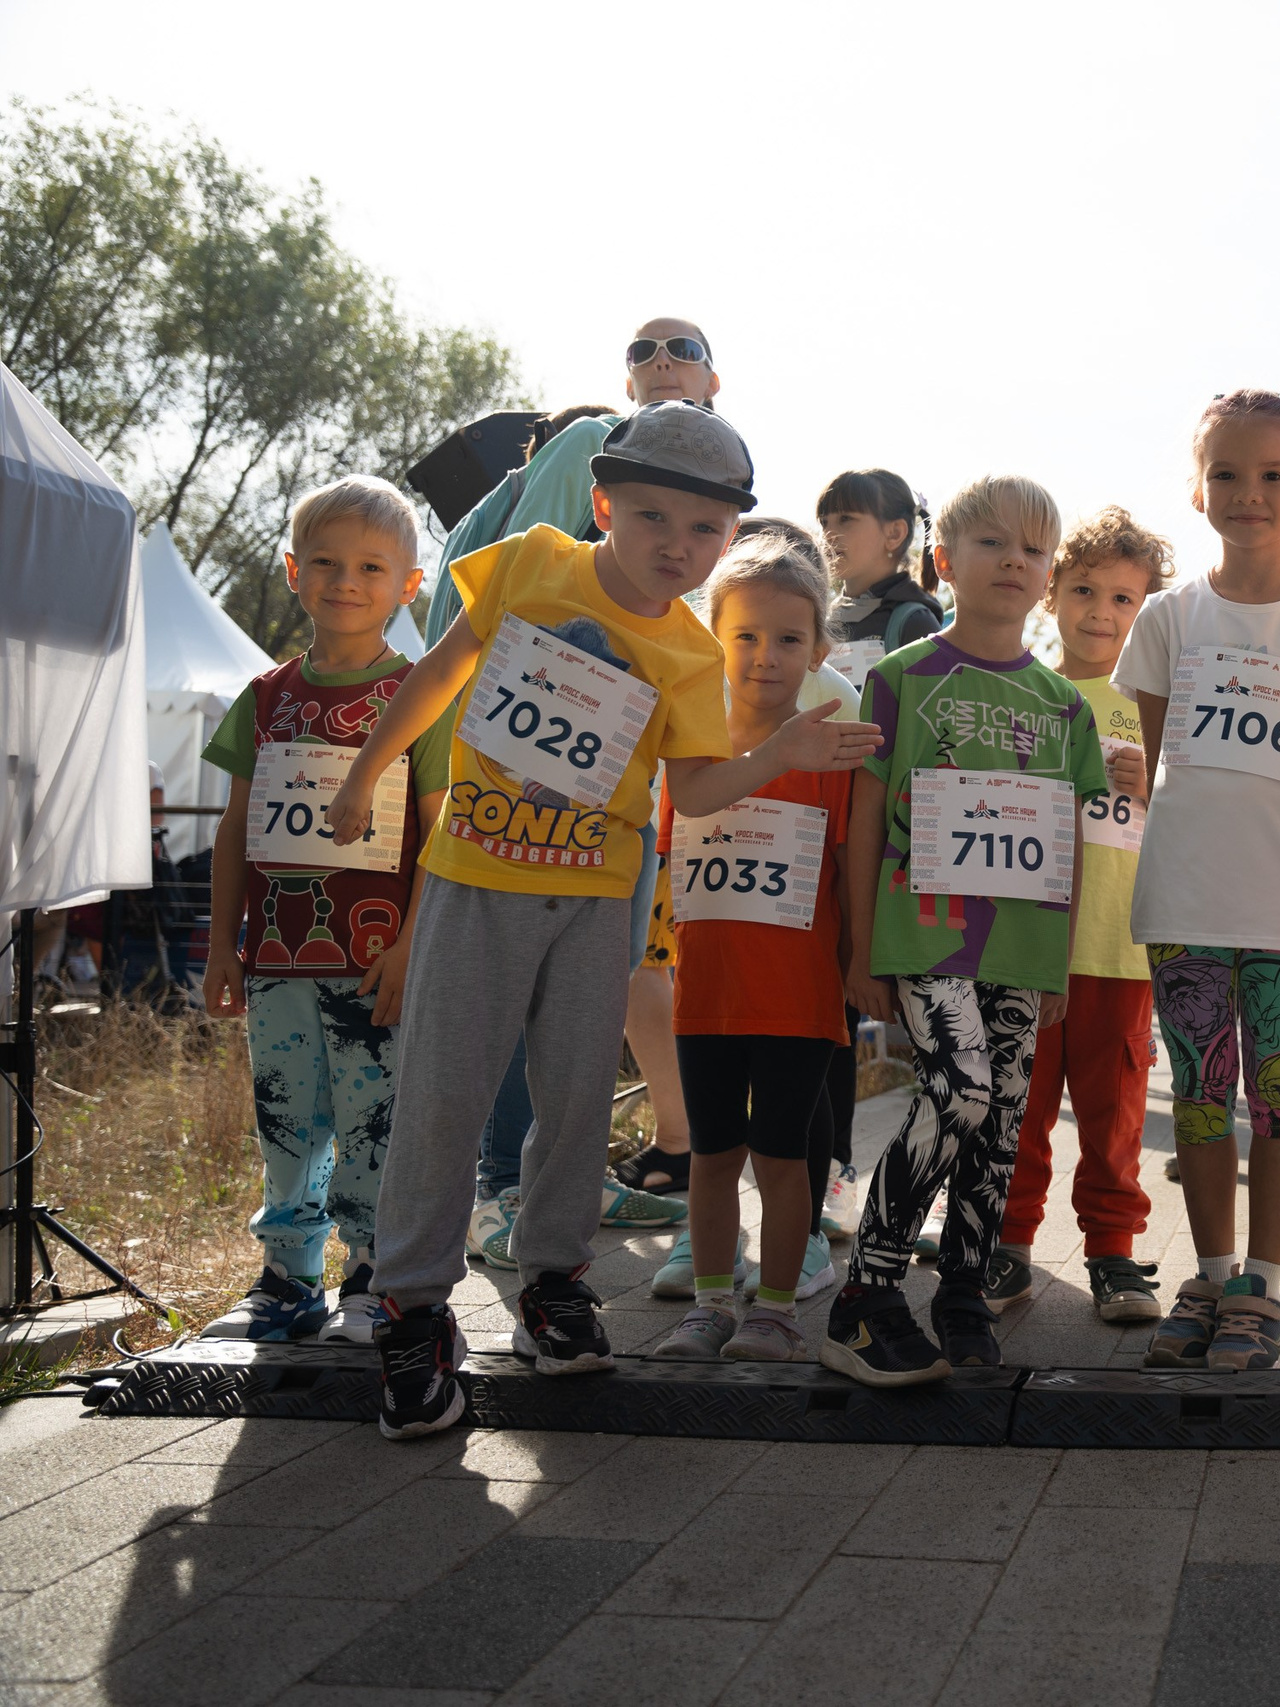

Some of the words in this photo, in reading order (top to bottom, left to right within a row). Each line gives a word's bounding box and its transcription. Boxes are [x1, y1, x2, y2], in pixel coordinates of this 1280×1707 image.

[560, 683, 580, 699] КРОСС
[581, 693, 601, 709] НАЦИИ
[1253, 684, 1271, 694] КРОСС
[485, 686, 602, 769] 7028
[320, 777, 338, 785] КРОСС
[451, 781, 608, 849] SONIC
[1002, 806, 1019, 814] КРОСС
[1020, 807, 1036, 817] НАЦИИ
[1087, 792, 1131, 825] 56
[450, 821, 473, 838] HE
[482, 838, 602, 865] HEDGEHOG
[735, 830, 753, 838] КРОСС
[754, 831, 774, 840] НАЦИИ
[952, 831, 1044, 871] 7110
[686, 857, 789, 896] 7033
